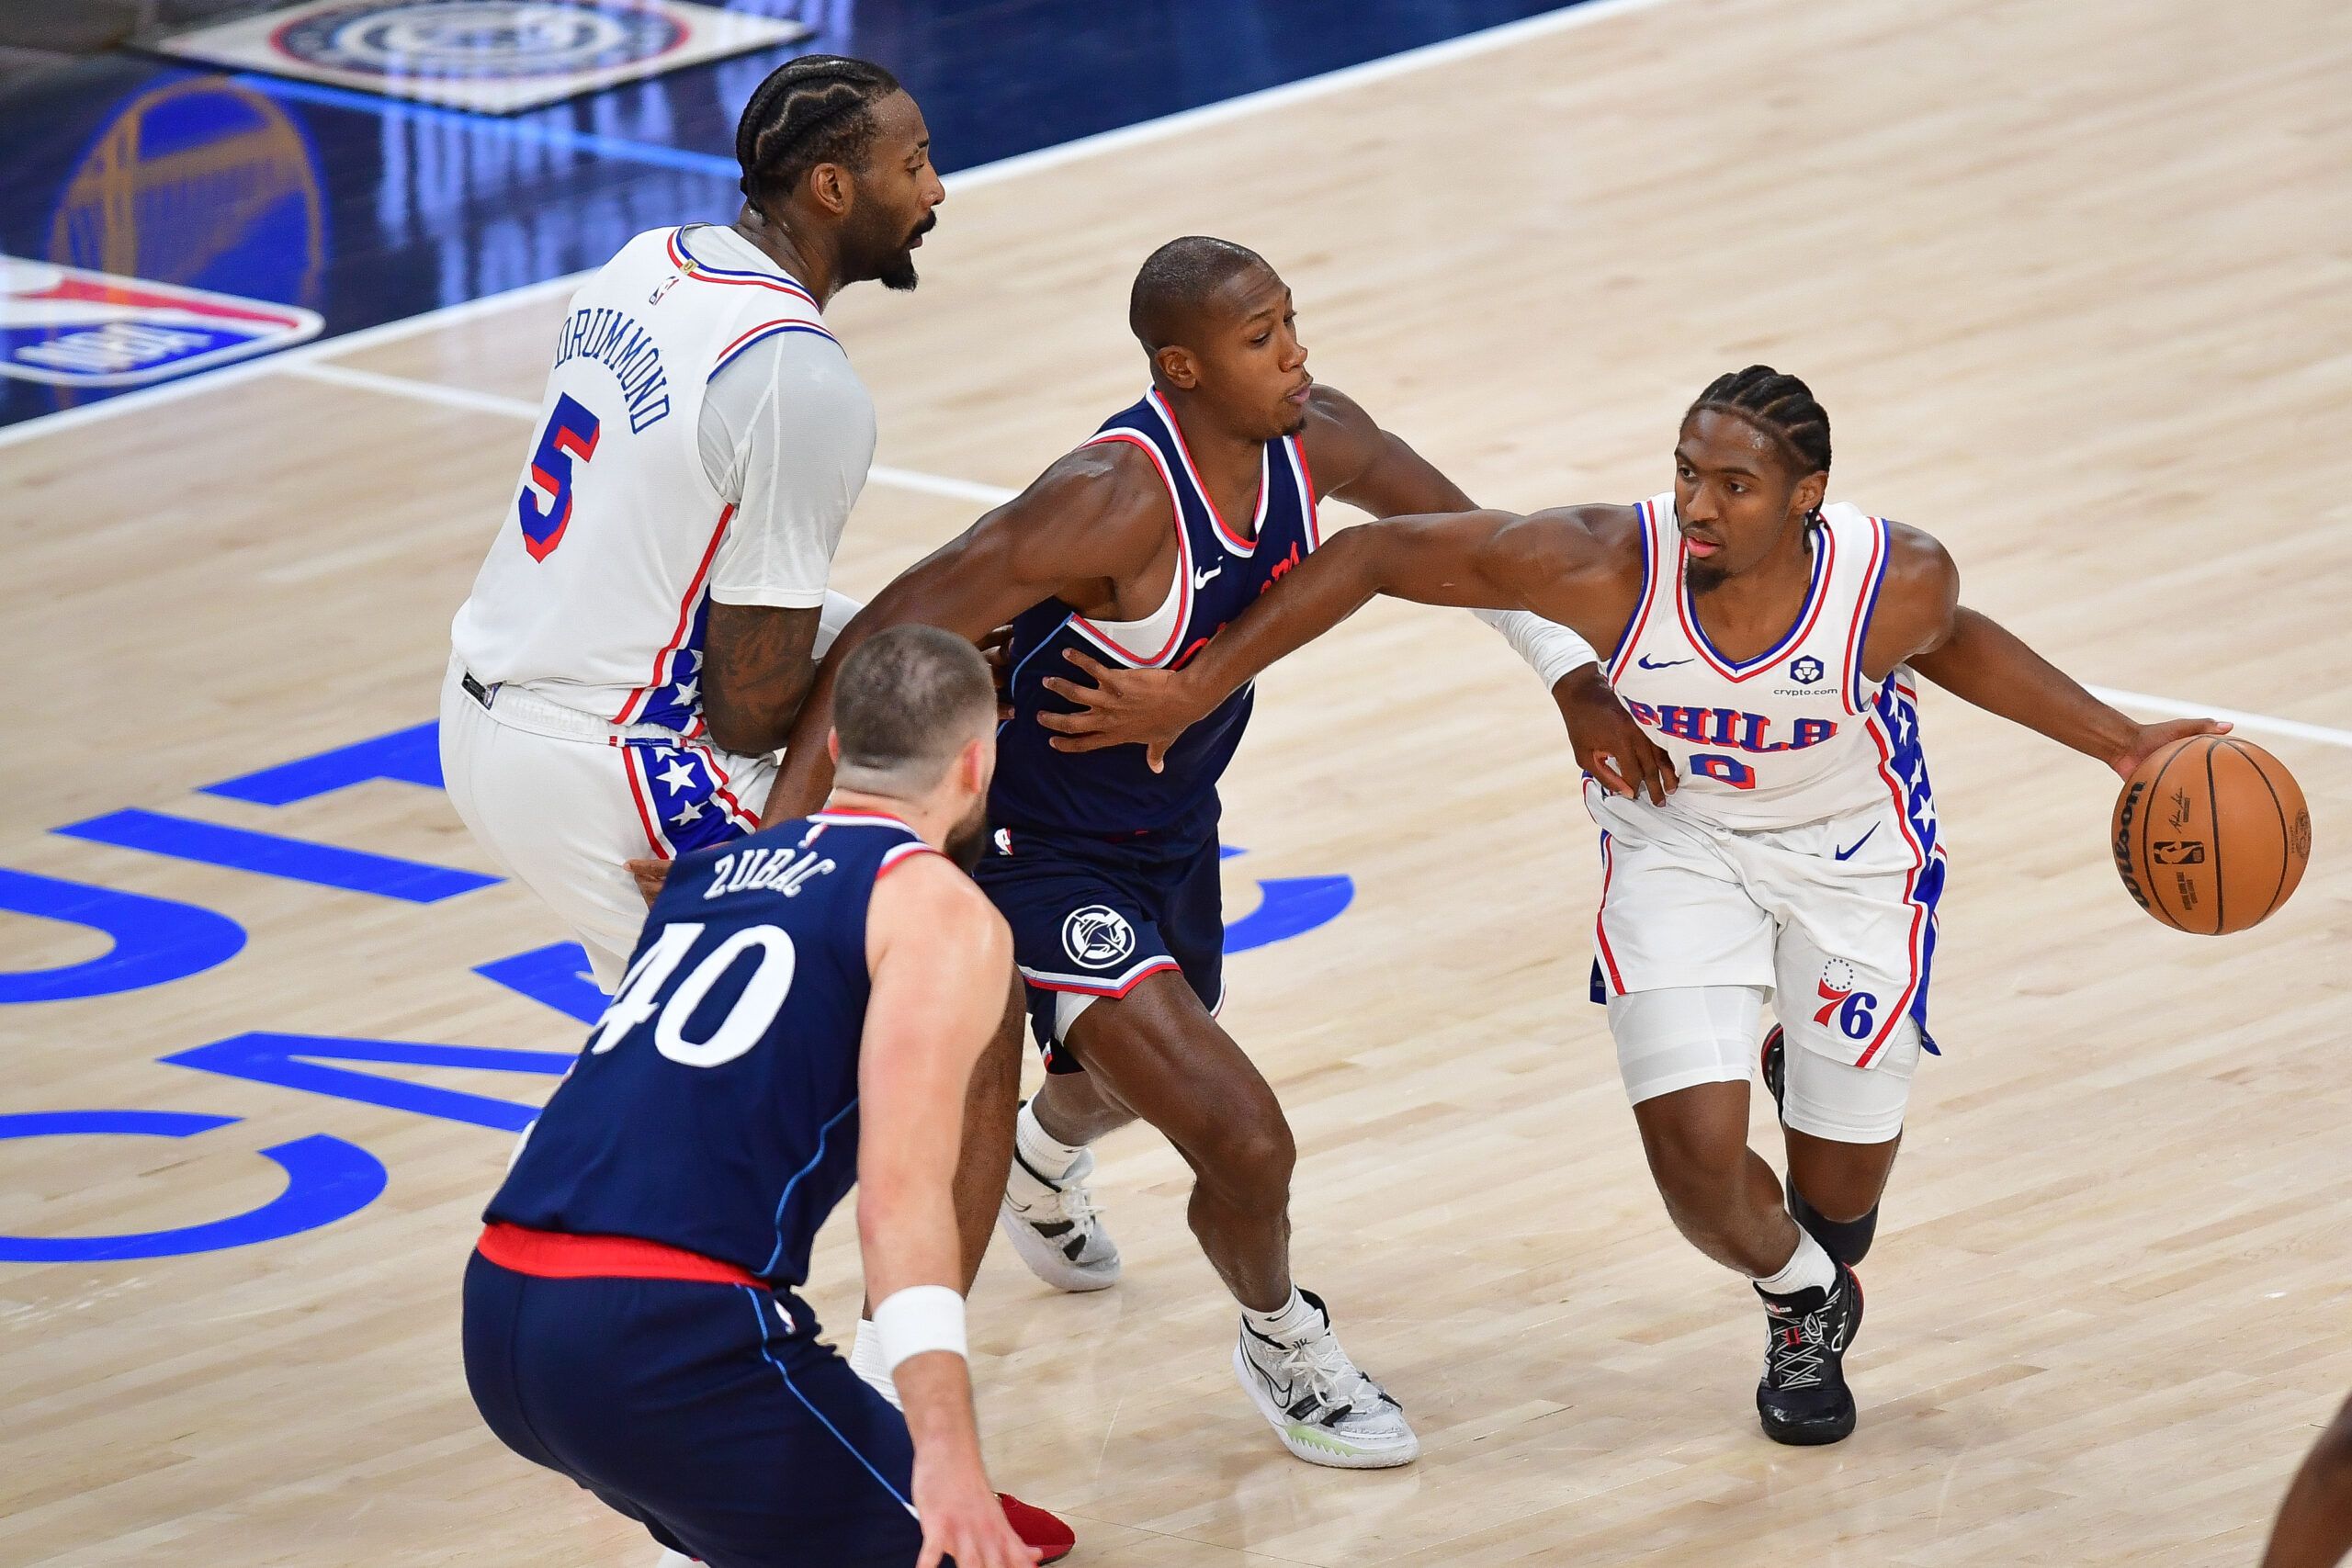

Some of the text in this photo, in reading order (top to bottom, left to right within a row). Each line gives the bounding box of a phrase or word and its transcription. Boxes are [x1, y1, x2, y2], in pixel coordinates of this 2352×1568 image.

[553, 308, 671, 435] DRUMMOND
[517, 391, 600, 564] 5
[1773, 688, 1838, 697] crypto.com
[1623, 695, 1838, 752] PHILA
[1689, 752, 1756, 790] 0
[703, 848, 837, 900] ZUBAC
[591, 922, 797, 1068] 40
[1813, 976, 1878, 1040] 76
